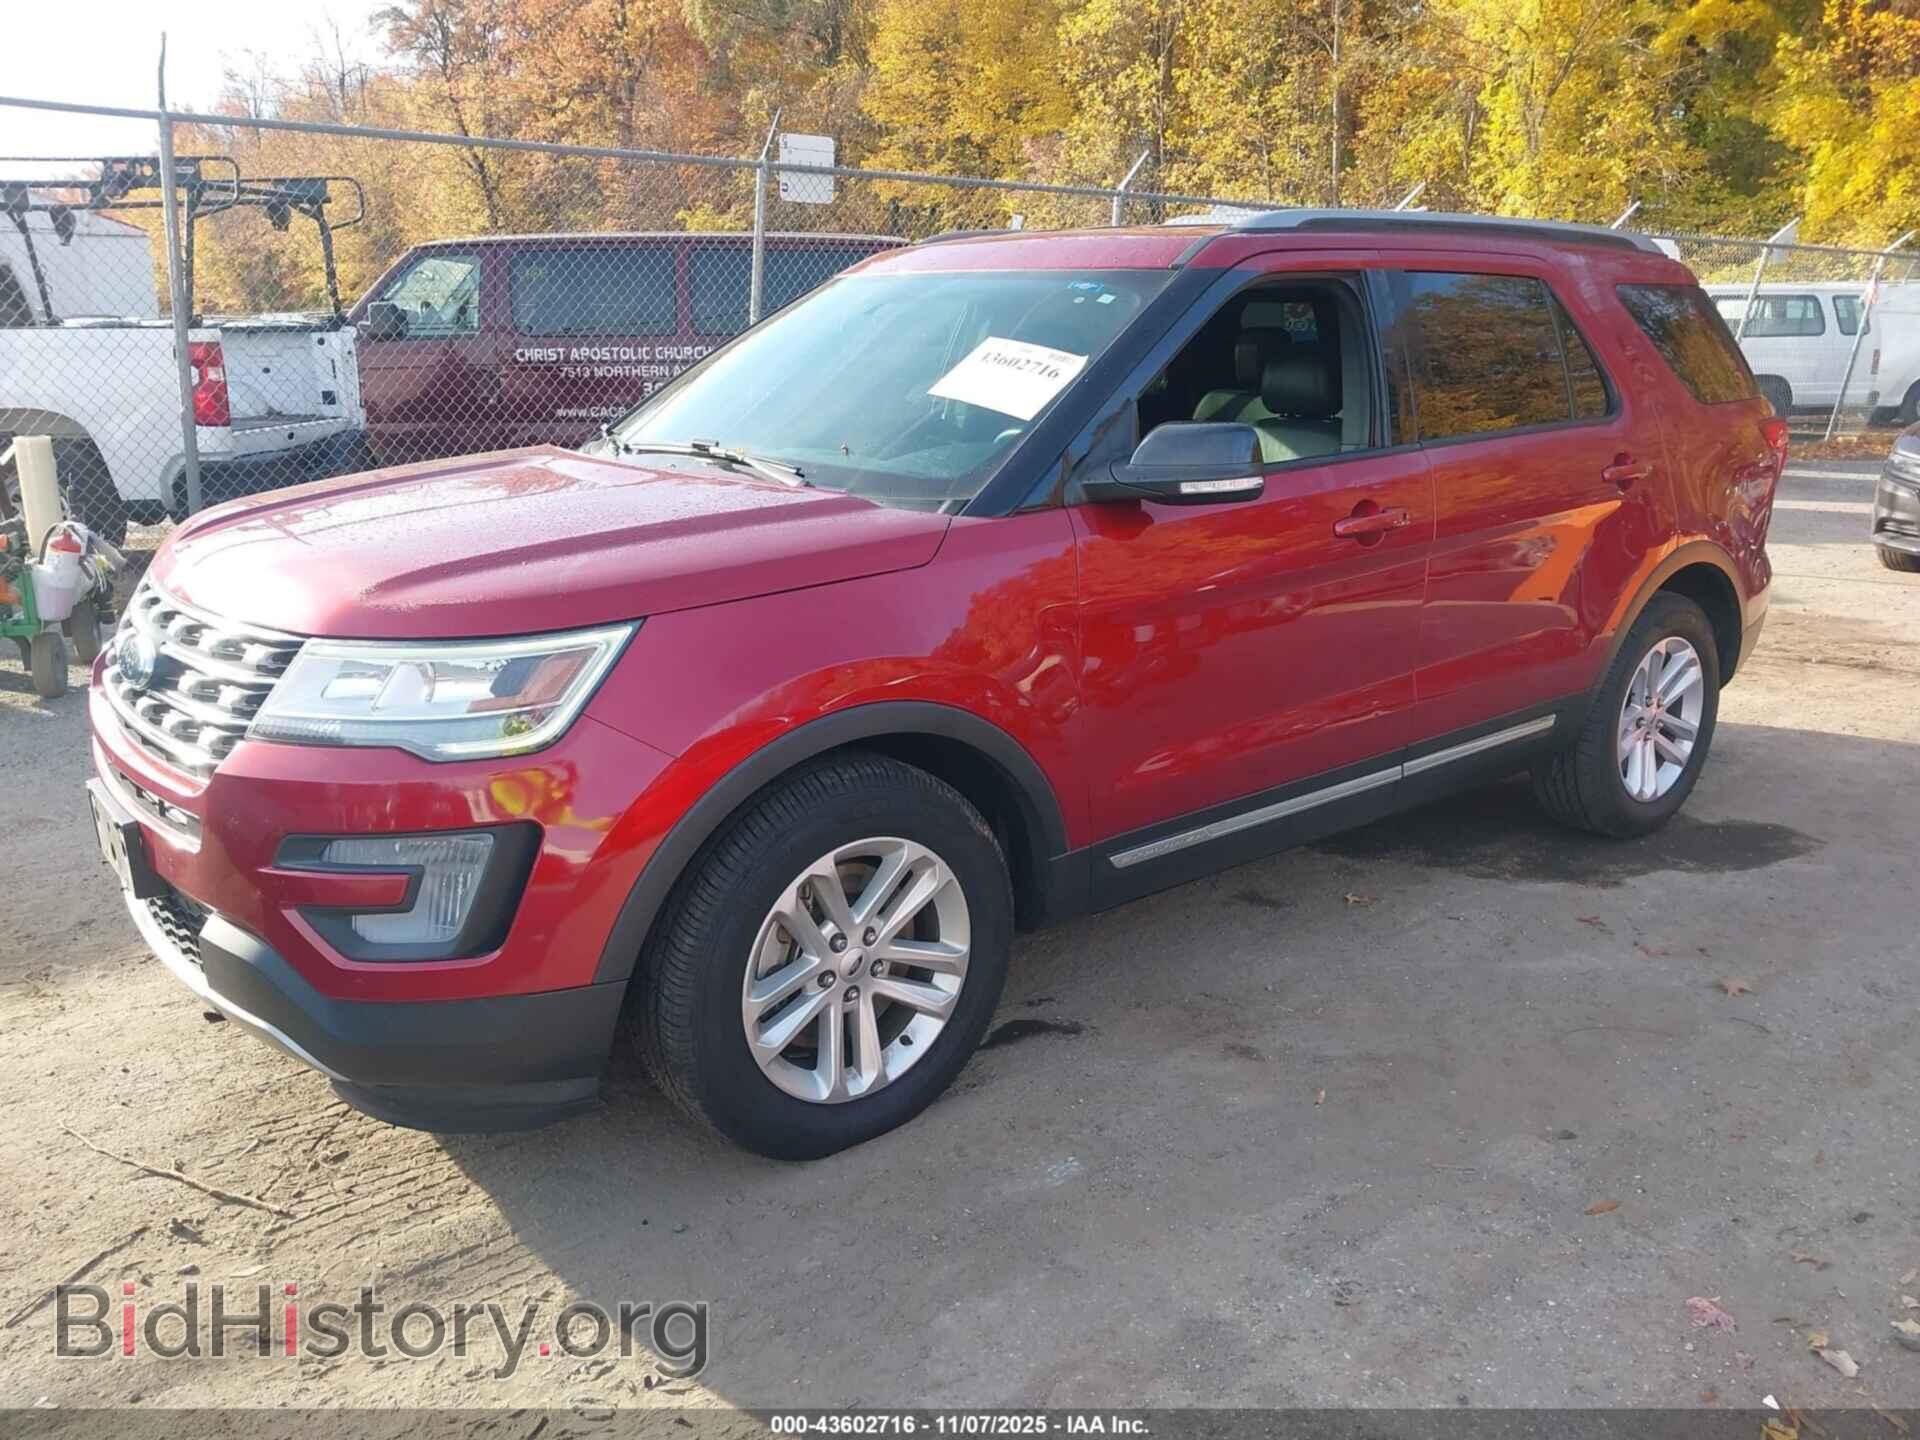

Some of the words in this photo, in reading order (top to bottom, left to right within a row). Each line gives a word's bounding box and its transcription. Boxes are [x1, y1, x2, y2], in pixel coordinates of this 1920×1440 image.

[515, 348, 565, 361] CHRIST
[570, 346, 651, 361] APOSTOLIC
[655, 346, 711, 360] CHURCH
[593, 366, 669, 378] NORTHERN
